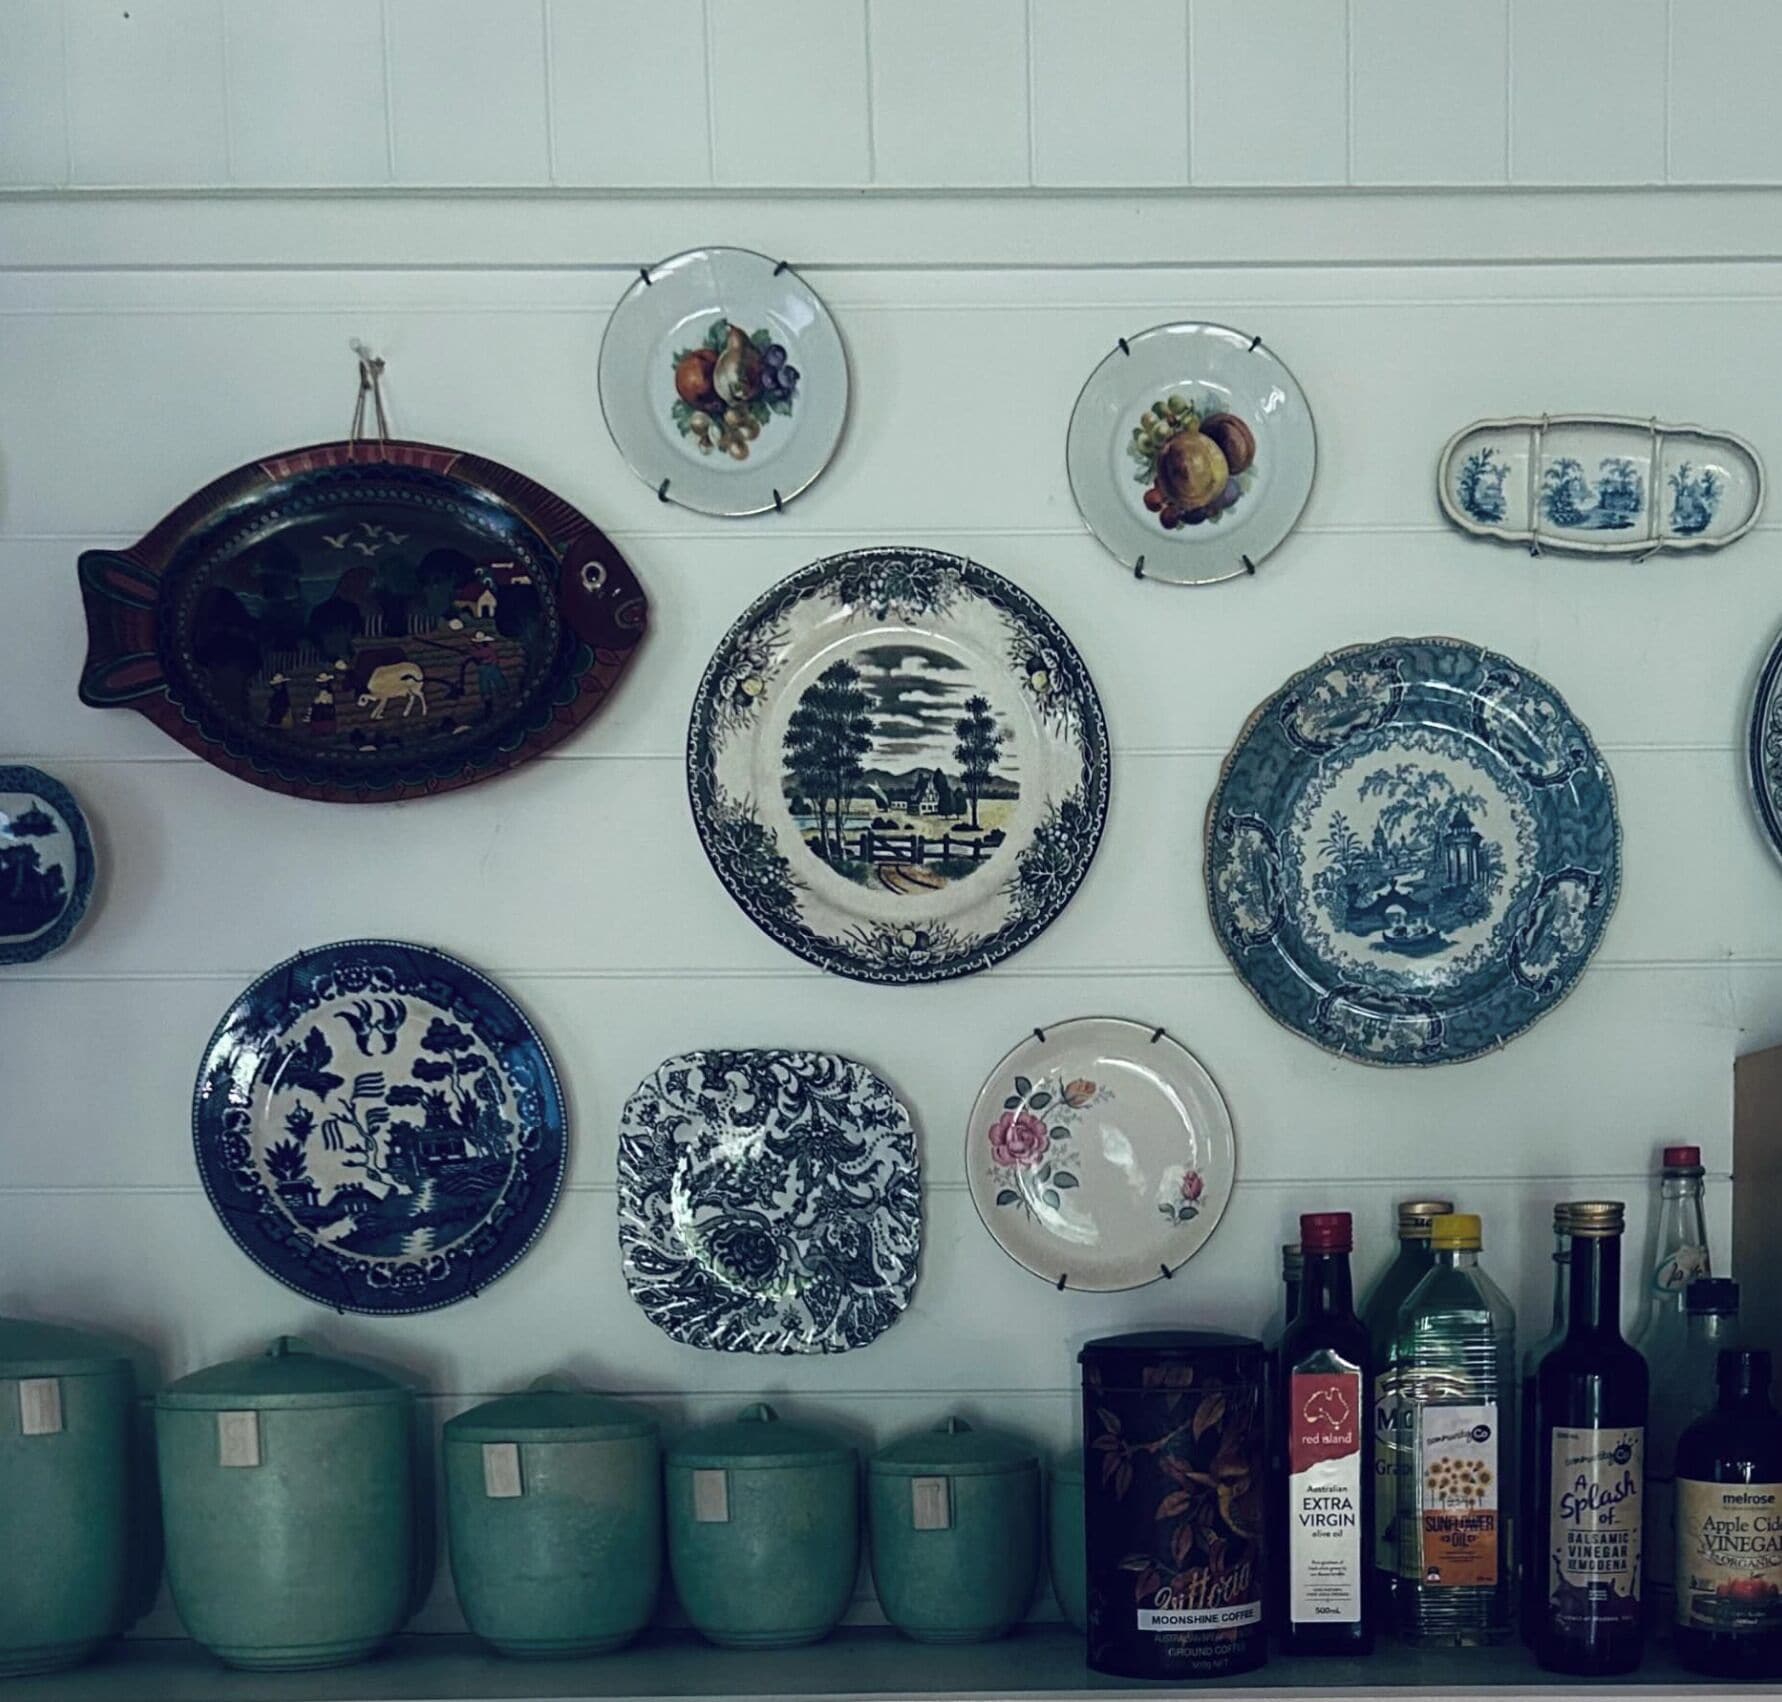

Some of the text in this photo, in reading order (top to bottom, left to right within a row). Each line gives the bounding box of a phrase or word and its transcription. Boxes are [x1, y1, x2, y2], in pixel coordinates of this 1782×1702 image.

[1302, 1432, 1352, 1444] red island
[1307, 1485, 1347, 1493] Australian
[1575, 1474, 1587, 1492] A
[1560, 1470, 1636, 1524] Splash
[1723, 1493, 1775, 1504] melrose
[1303, 1497, 1353, 1511] EXTRA
[1299, 1513, 1355, 1527] VIRGIN
[1703, 1515, 1750, 1535] Apple
[1312, 1529, 1343, 1538] olive oil
[1452, 1532, 1469, 1547] OIL
[1567, 1532, 1629, 1544] BALSAMIC
[1568, 1545, 1628, 1558] VINEGAR
[1578, 1559, 1627, 1571] MODENA
[1152, 1609, 1255, 1625] MOONSHINE COFFEE
